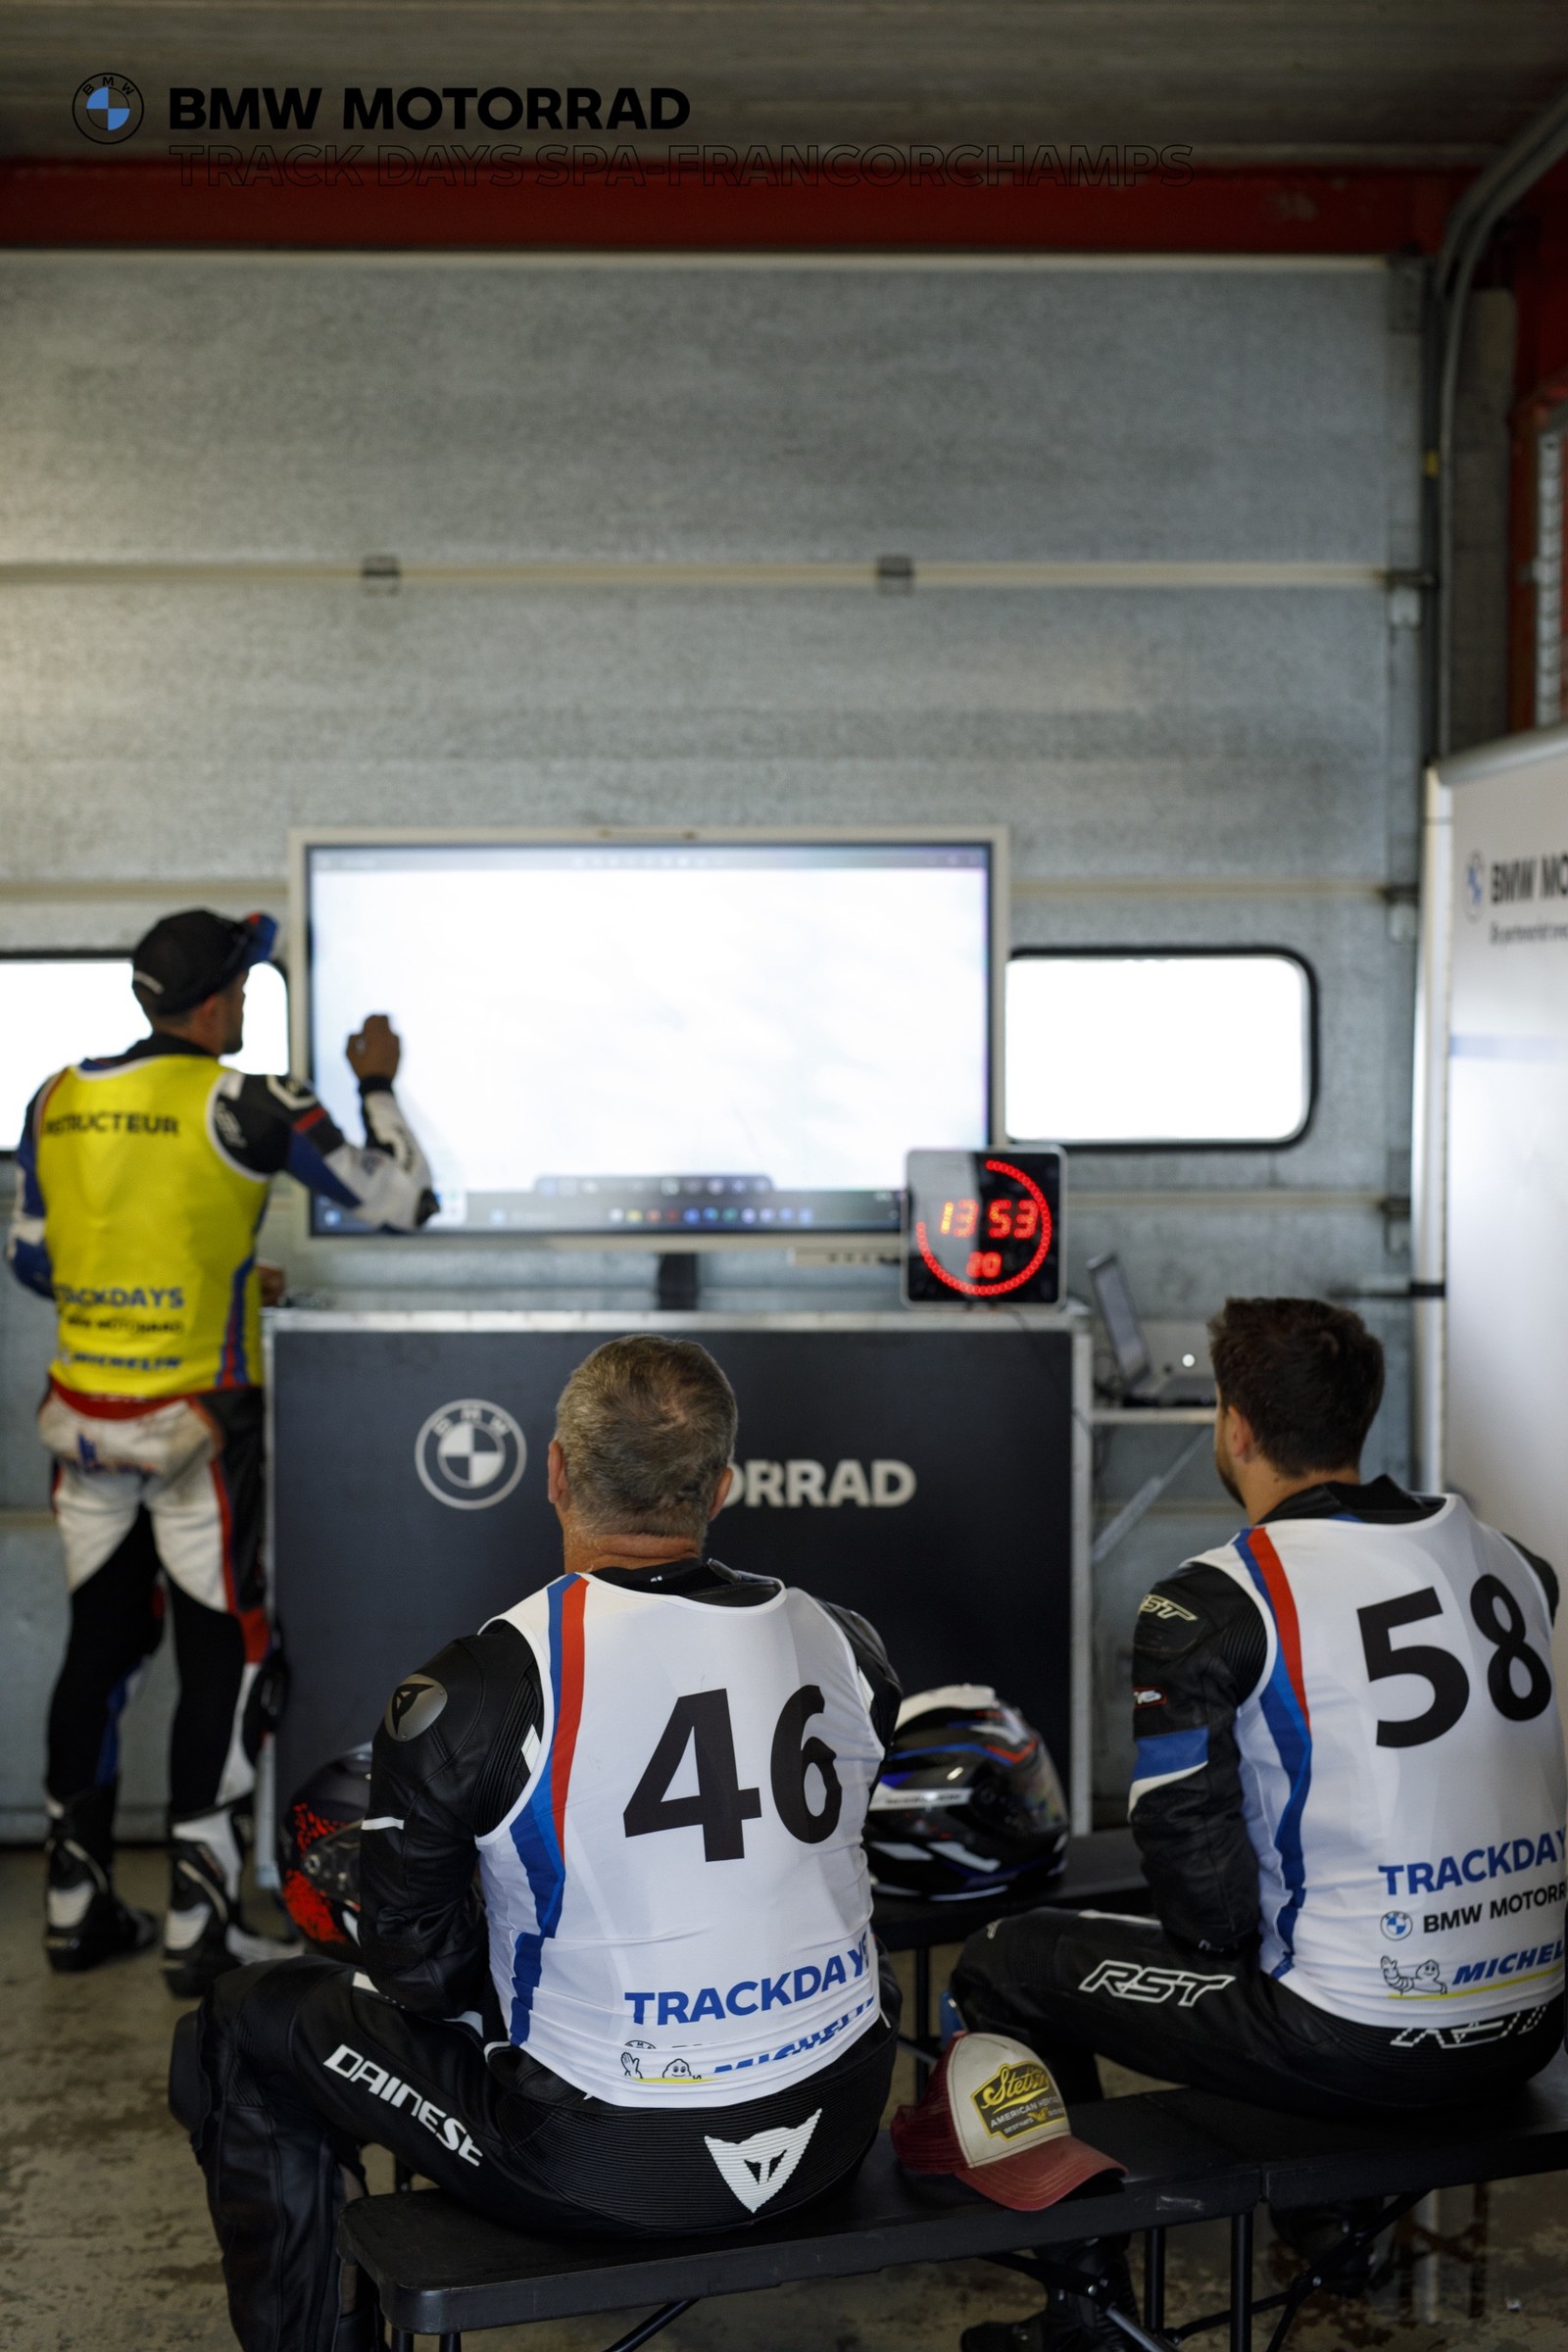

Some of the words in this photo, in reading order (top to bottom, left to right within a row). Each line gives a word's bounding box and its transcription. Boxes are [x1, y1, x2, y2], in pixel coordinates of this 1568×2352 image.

[940, 1199, 979, 1239] 13
[988, 1199, 1040, 1239] 53
[1138, 1593, 1198, 1622] ST
[1357, 1573, 1552, 1747] 58
[623, 1685, 842, 1862] 46
[1423, 1903, 1483, 1934] BMW
[1079, 1959, 1237, 2007] RST
[322, 2043, 483, 2167] DAINESE
[990, 2102, 1039, 2129] AMERICAN
